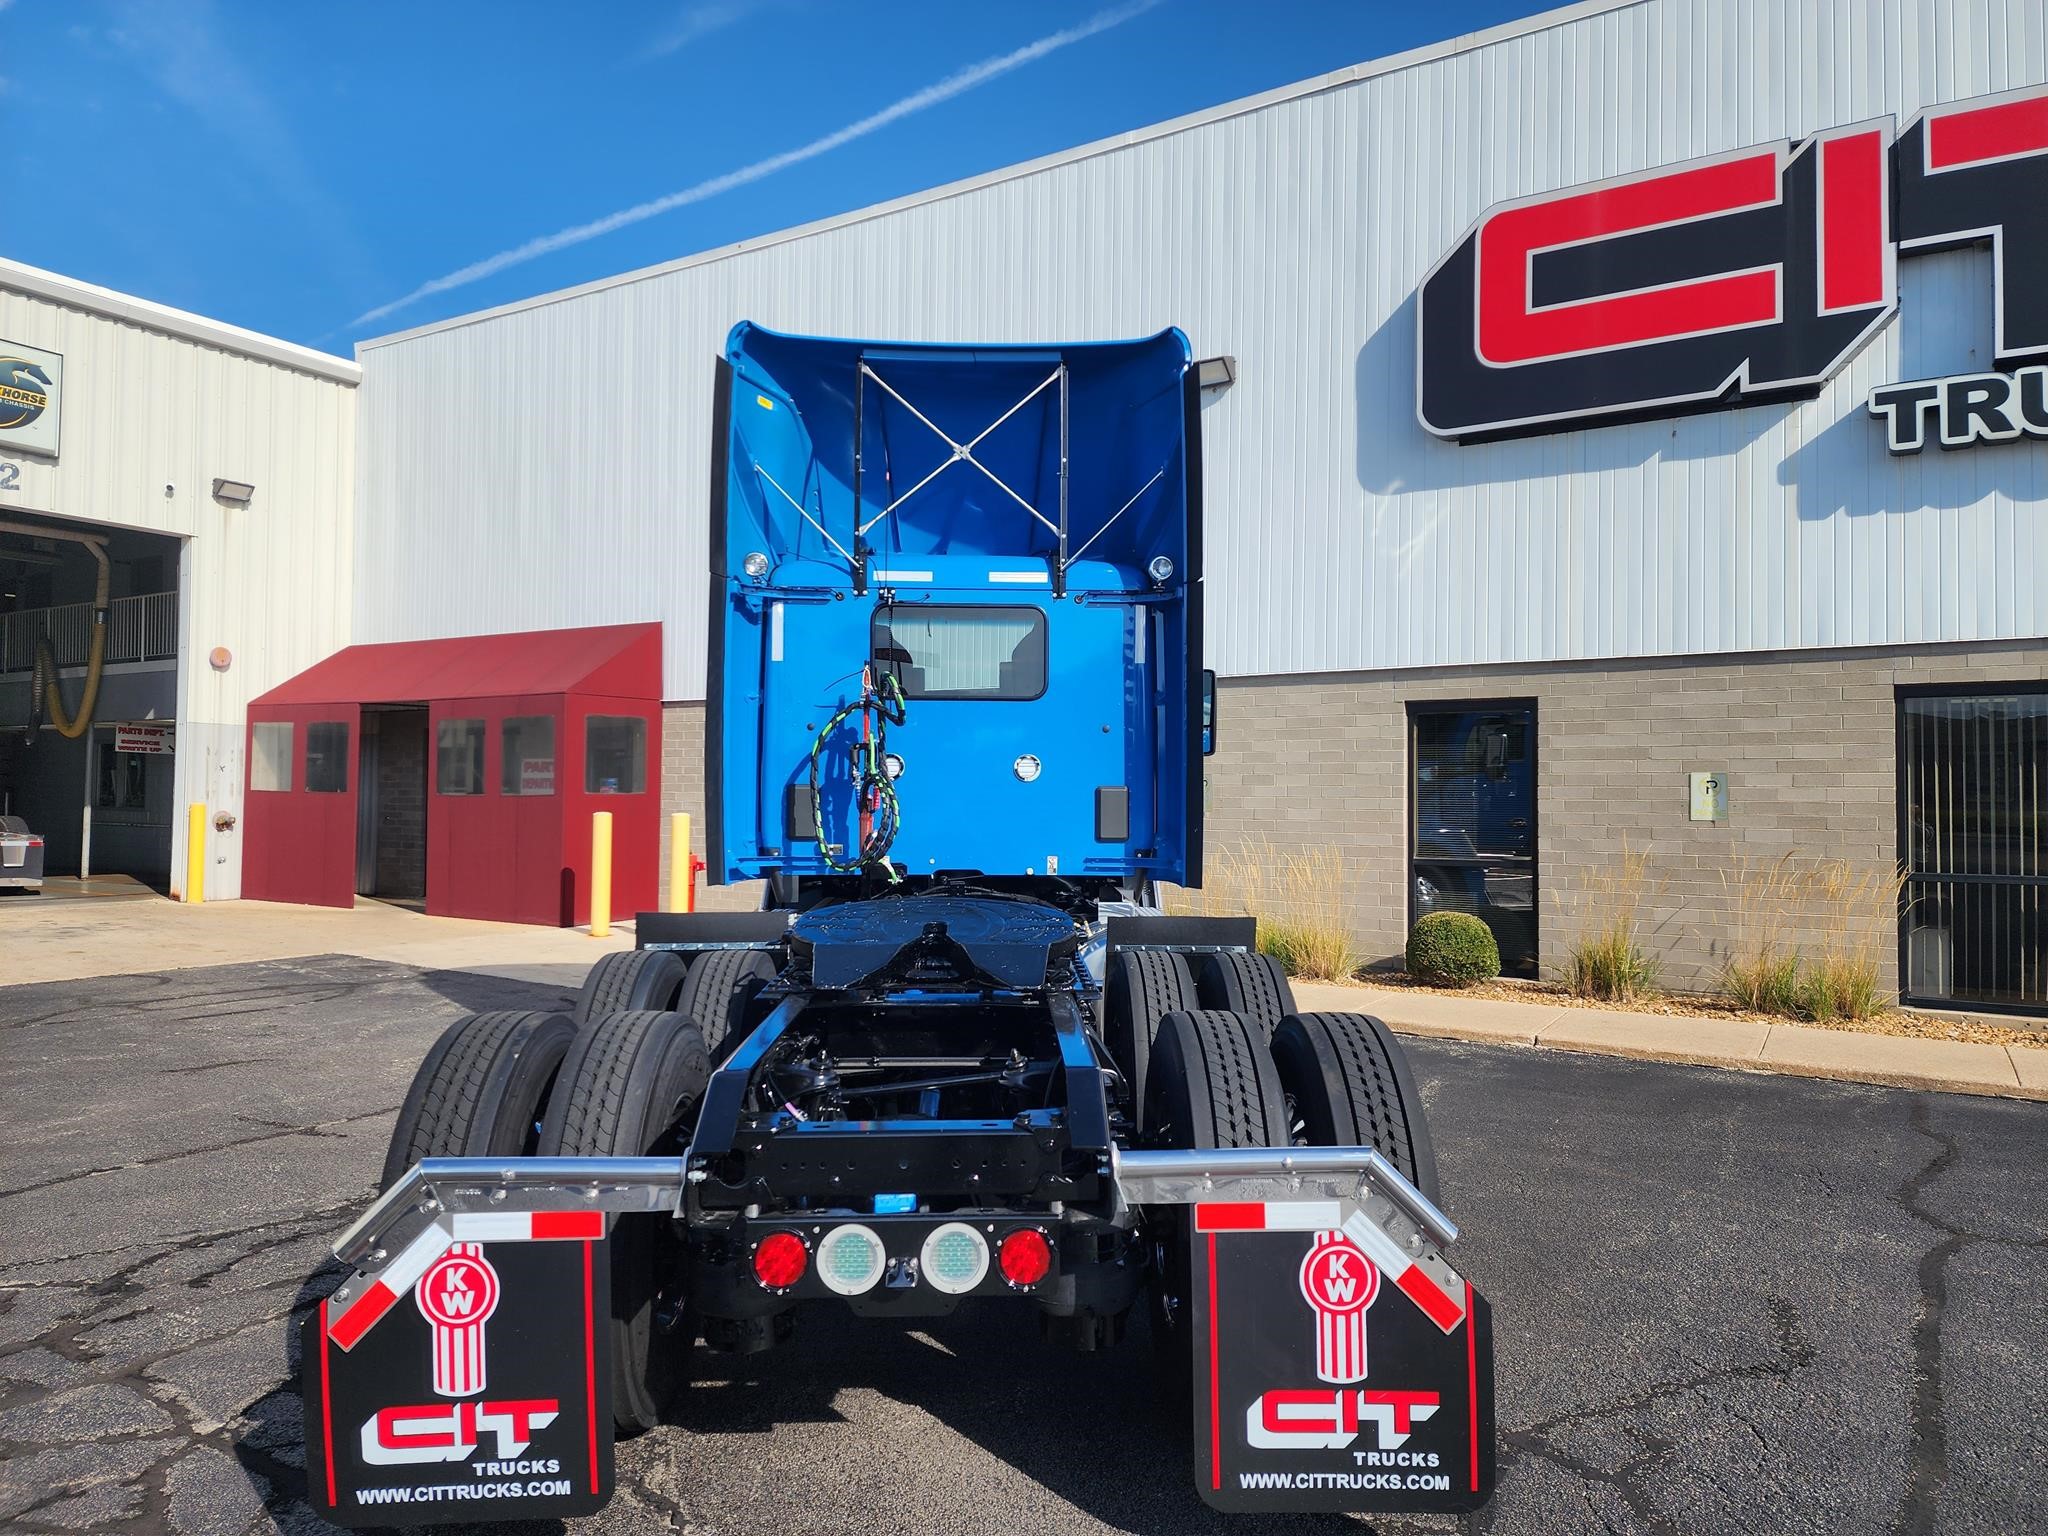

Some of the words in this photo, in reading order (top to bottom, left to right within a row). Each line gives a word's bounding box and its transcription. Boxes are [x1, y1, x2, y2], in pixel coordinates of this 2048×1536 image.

[0, 386, 47, 406] HORSE
[4, 399, 35, 411] CHASSIS
[118, 726, 142, 736] PARTS
[1247, 1389, 1440, 1449] CIT
[361, 1399, 559, 1465] CIT
[472, 1459, 560, 1476] TRUCKS
[1354, 1452, 1440, 1467] TRUCKS
[1240, 1473, 1450, 1491] WWW.CITTRUCKS.COM
[356, 1480, 571, 1505] WWW.CITTRUCKS.COM
